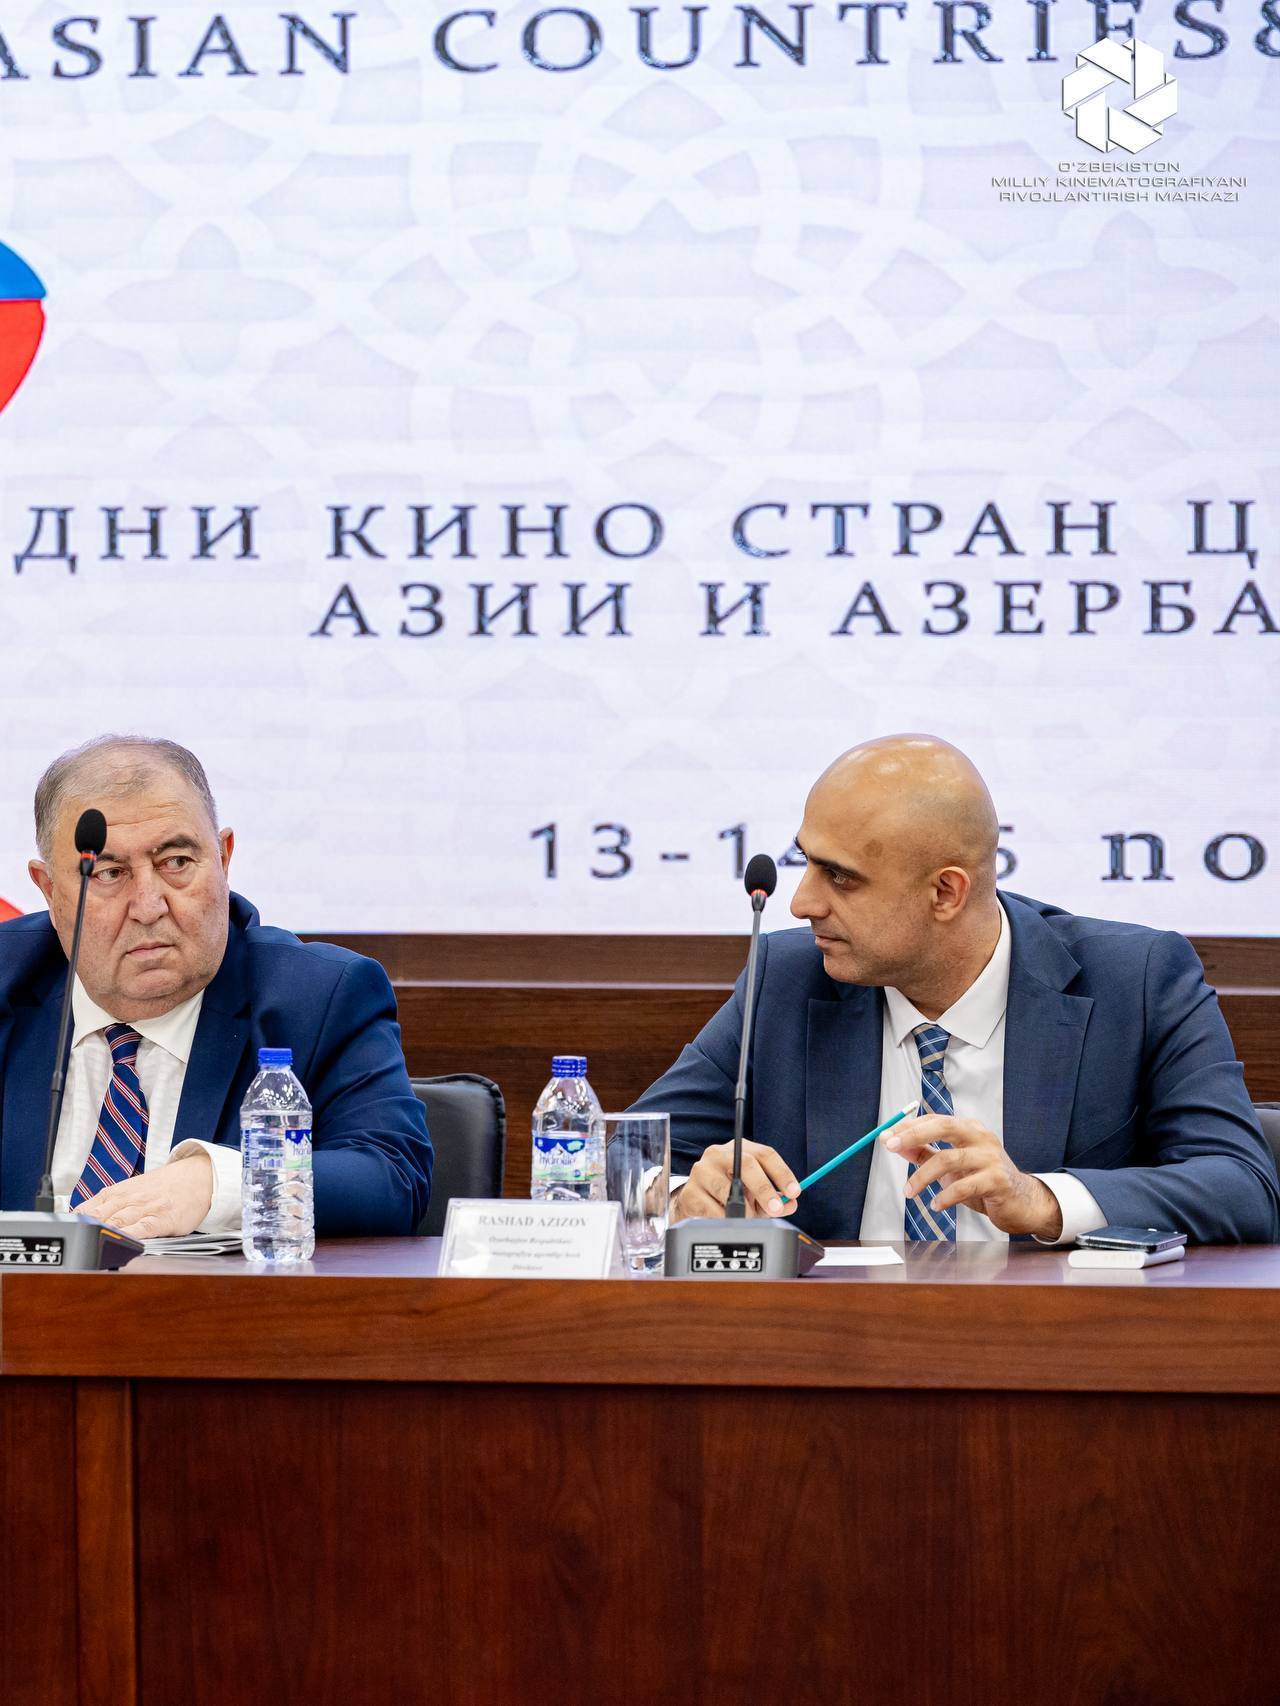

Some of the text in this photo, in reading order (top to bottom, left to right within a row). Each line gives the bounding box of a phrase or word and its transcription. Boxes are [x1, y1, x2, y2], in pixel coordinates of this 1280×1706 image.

[14, 500, 1258, 573] ДНИ КИНО СТРАН Ц
[310, 580, 1280, 637] АЗИИ И АЗЕРБА
[478, 1215, 590, 1228] RASHAD AZIZOV
